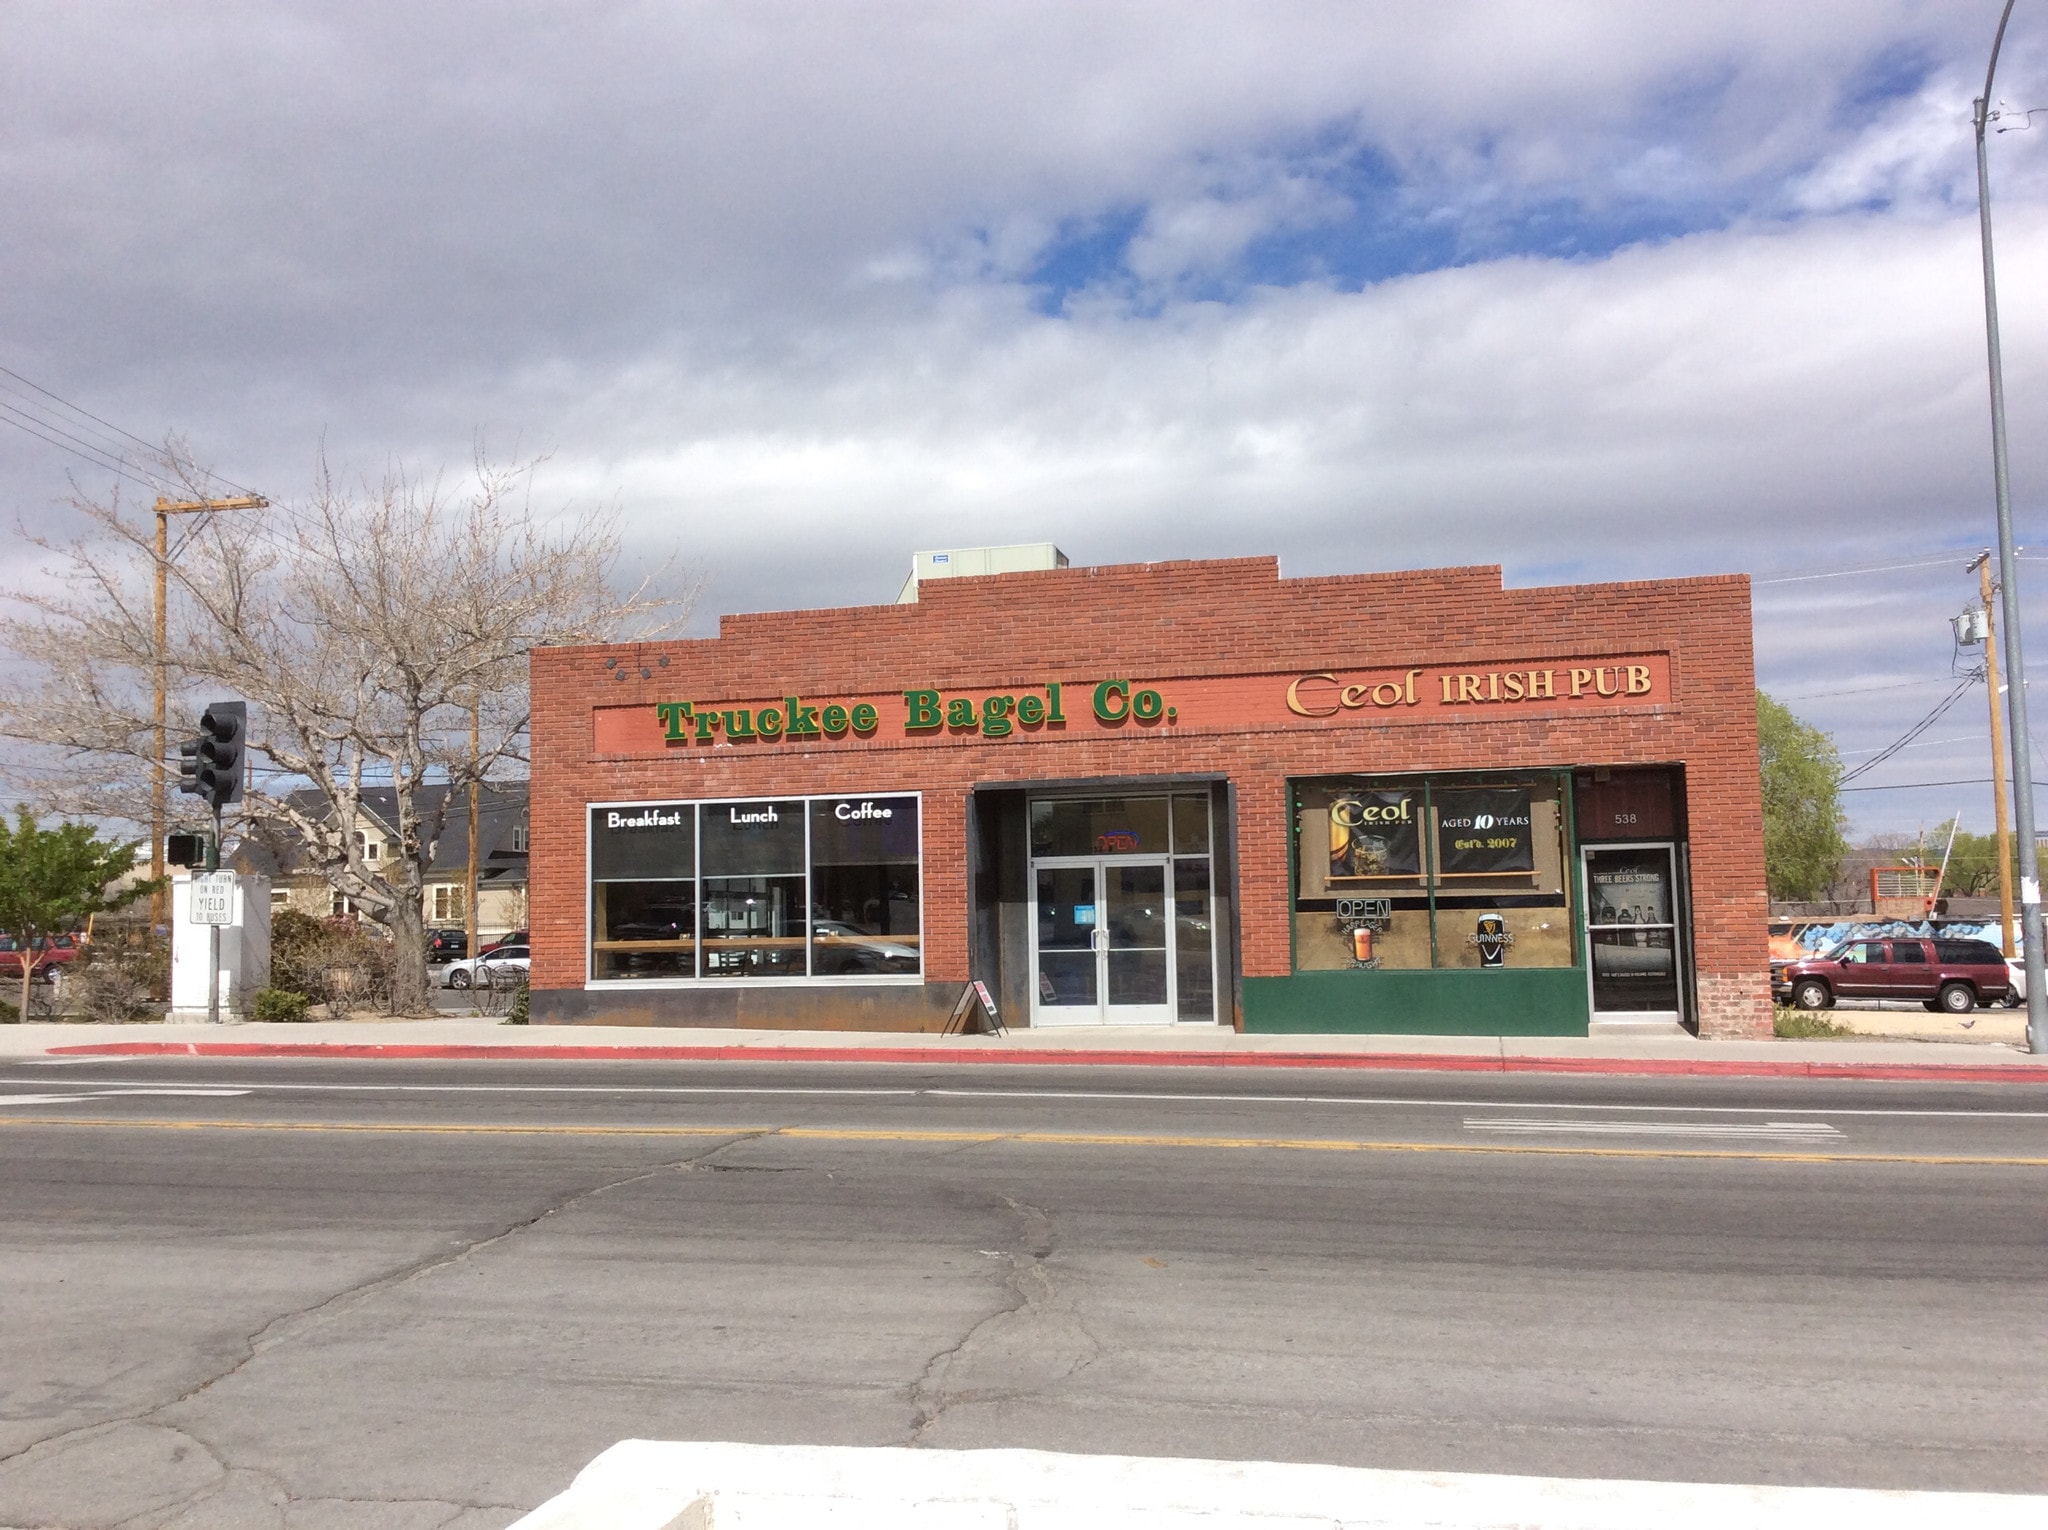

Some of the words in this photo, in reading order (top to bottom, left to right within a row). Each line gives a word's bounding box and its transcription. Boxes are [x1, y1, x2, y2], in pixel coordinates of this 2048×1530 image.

[1286, 668, 1424, 717] Ceol
[1438, 668, 1557, 705] IRISH
[1567, 664, 1653, 699] PUB
[657, 696, 878, 740] Truckee
[902, 682, 1067, 736] Bagel
[1093, 679, 1179, 721] Co.
[729, 805, 779, 824] Lunch
[834, 801, 893, 821] Coffee
[1331, 798, 1413, 827] Ceol
[1614, 813, 1638, 824] 538
[607, 810, 682, 829] Breakfast
[1441, 818, 1472, 829] AGED
[1474, 814, 1495, 830] 10
[1496, 816, 1529, 827] YEARS
[1095, 835, 1138, 851] OPEN
[1486, 837, 1518, 849] 2007
[216, 874, 231, 883] TURN
[1593, 874, 1613, 884] THREE
[1614, 873, 1634, 884] BEERS
[1635, 872, 1660, 883] STRONG
[200, 886, 207, 894] ON
[212, 886, 224, 894] RED
[199, 898, 224, 910] YIELD
[1339, 900, 1389, 917] OPEN
[196, 913, 202, 921] TO
[207, 913, 226, 921] BUSES
[1468, 932, 1514, 943] GUINNESS
